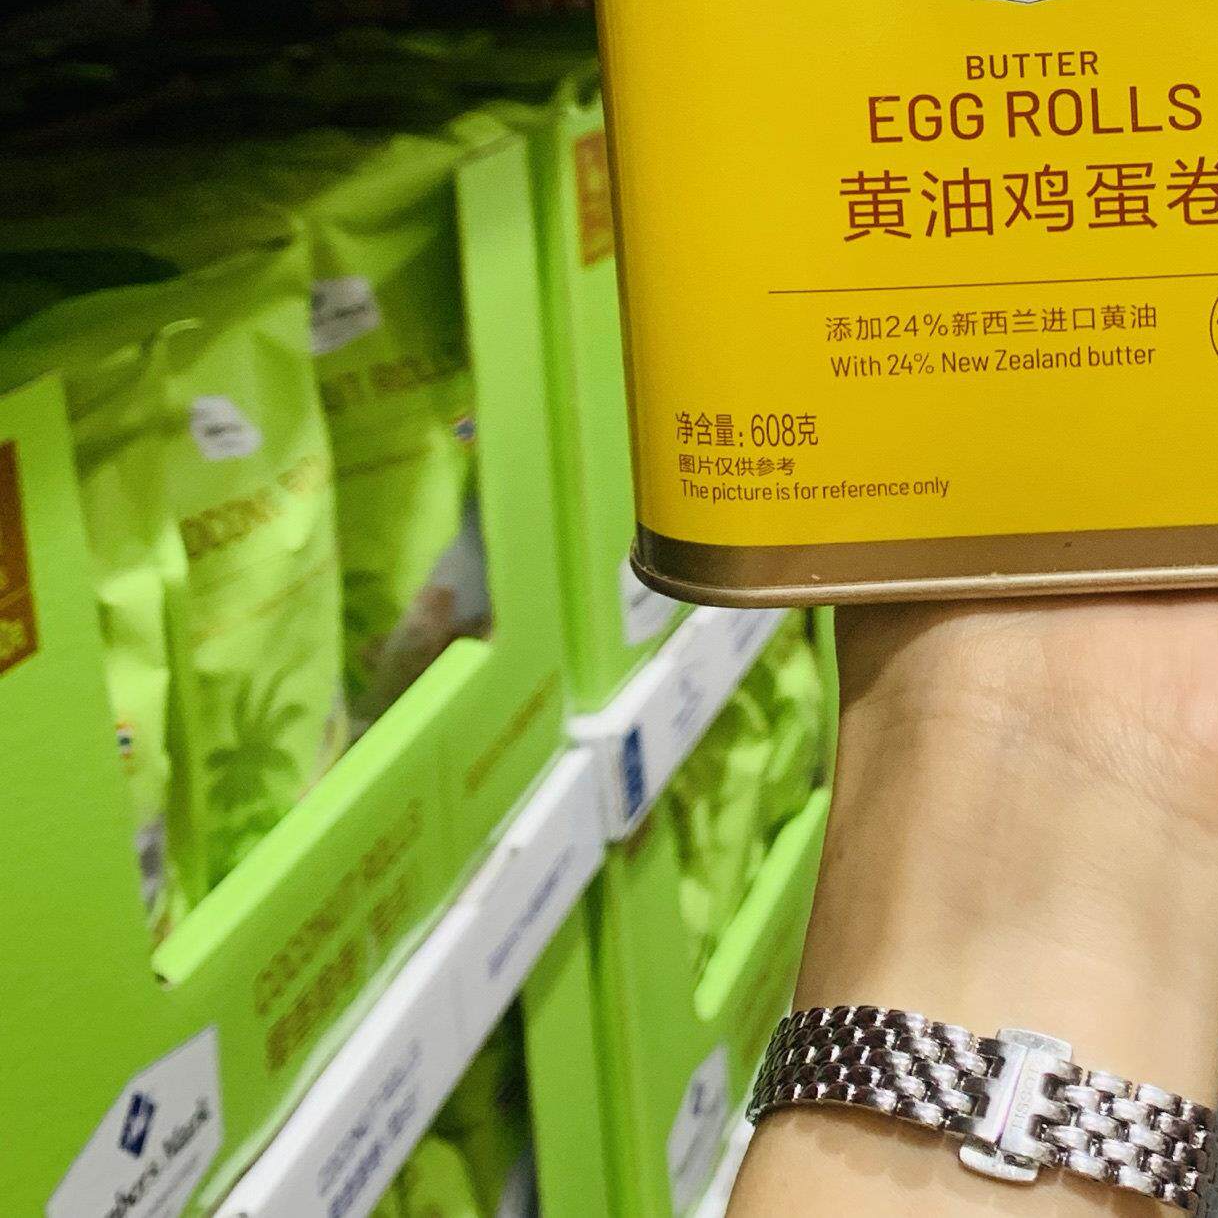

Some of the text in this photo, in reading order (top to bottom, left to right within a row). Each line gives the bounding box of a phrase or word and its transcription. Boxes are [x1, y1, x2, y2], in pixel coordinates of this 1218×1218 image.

[966, 51, 1098, 80] BUTTER
[869, 84, 1202, 143] EGG ROLLS
[826, 303, 1156, 341] 添加24%新西兰进口黄油
[831, 346, 1155, 377] With 24% New Zealand butter
[679, 454, 795, 476] 图片仅供参考
[680, 477, 949, 504] The picture is for reference only
